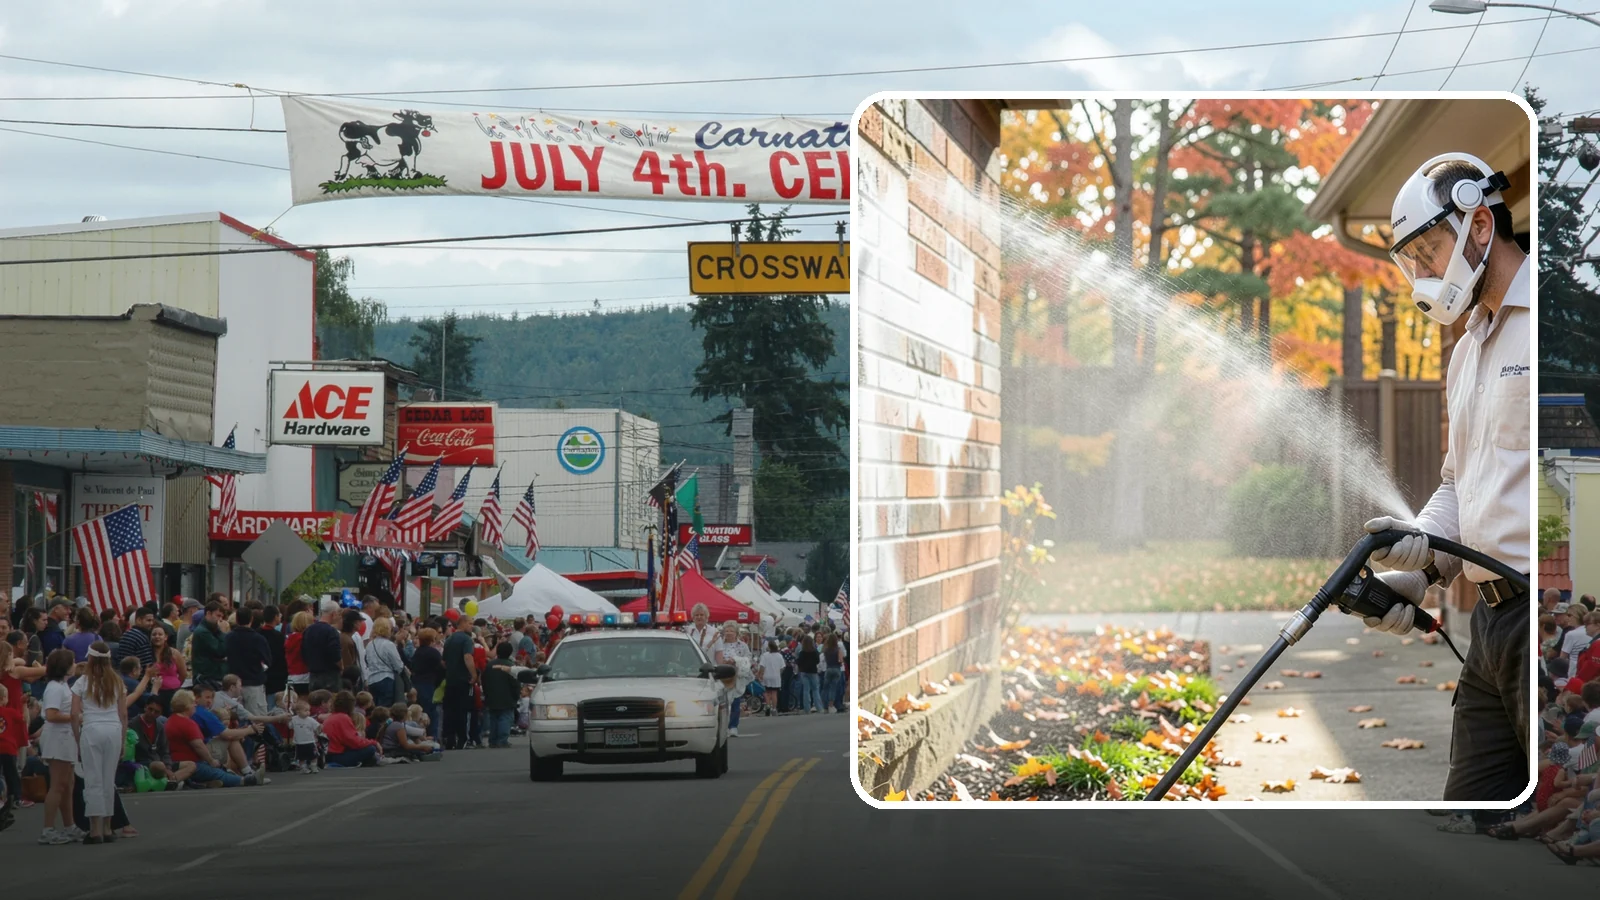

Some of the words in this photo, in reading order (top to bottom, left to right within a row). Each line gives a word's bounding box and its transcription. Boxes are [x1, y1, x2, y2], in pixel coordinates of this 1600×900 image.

[481, 141, 605, 192] JULY
[632, 150, 747, 199] 4th.
[696, 254, 850, 280] CROSSWA
[283, 380, 373, 420] ACE
[405, 409, 452, 422] CEDAR
[460, 409, 485, 422] LOG
[283, 421, 371, 436] Hardware
[416, 428, 477, 447] Coca-Cola
[353, 466, 386, 479] Simpl
[96, 484, 125, 495] Vincent
[126, 485, 136, 495] de
[137, 486, 155, 495] Paul
[81, 503, 154, 522] THT
[688, 526, 741, 535] CRNATION
[699, 535, 730, 543] GLASS
